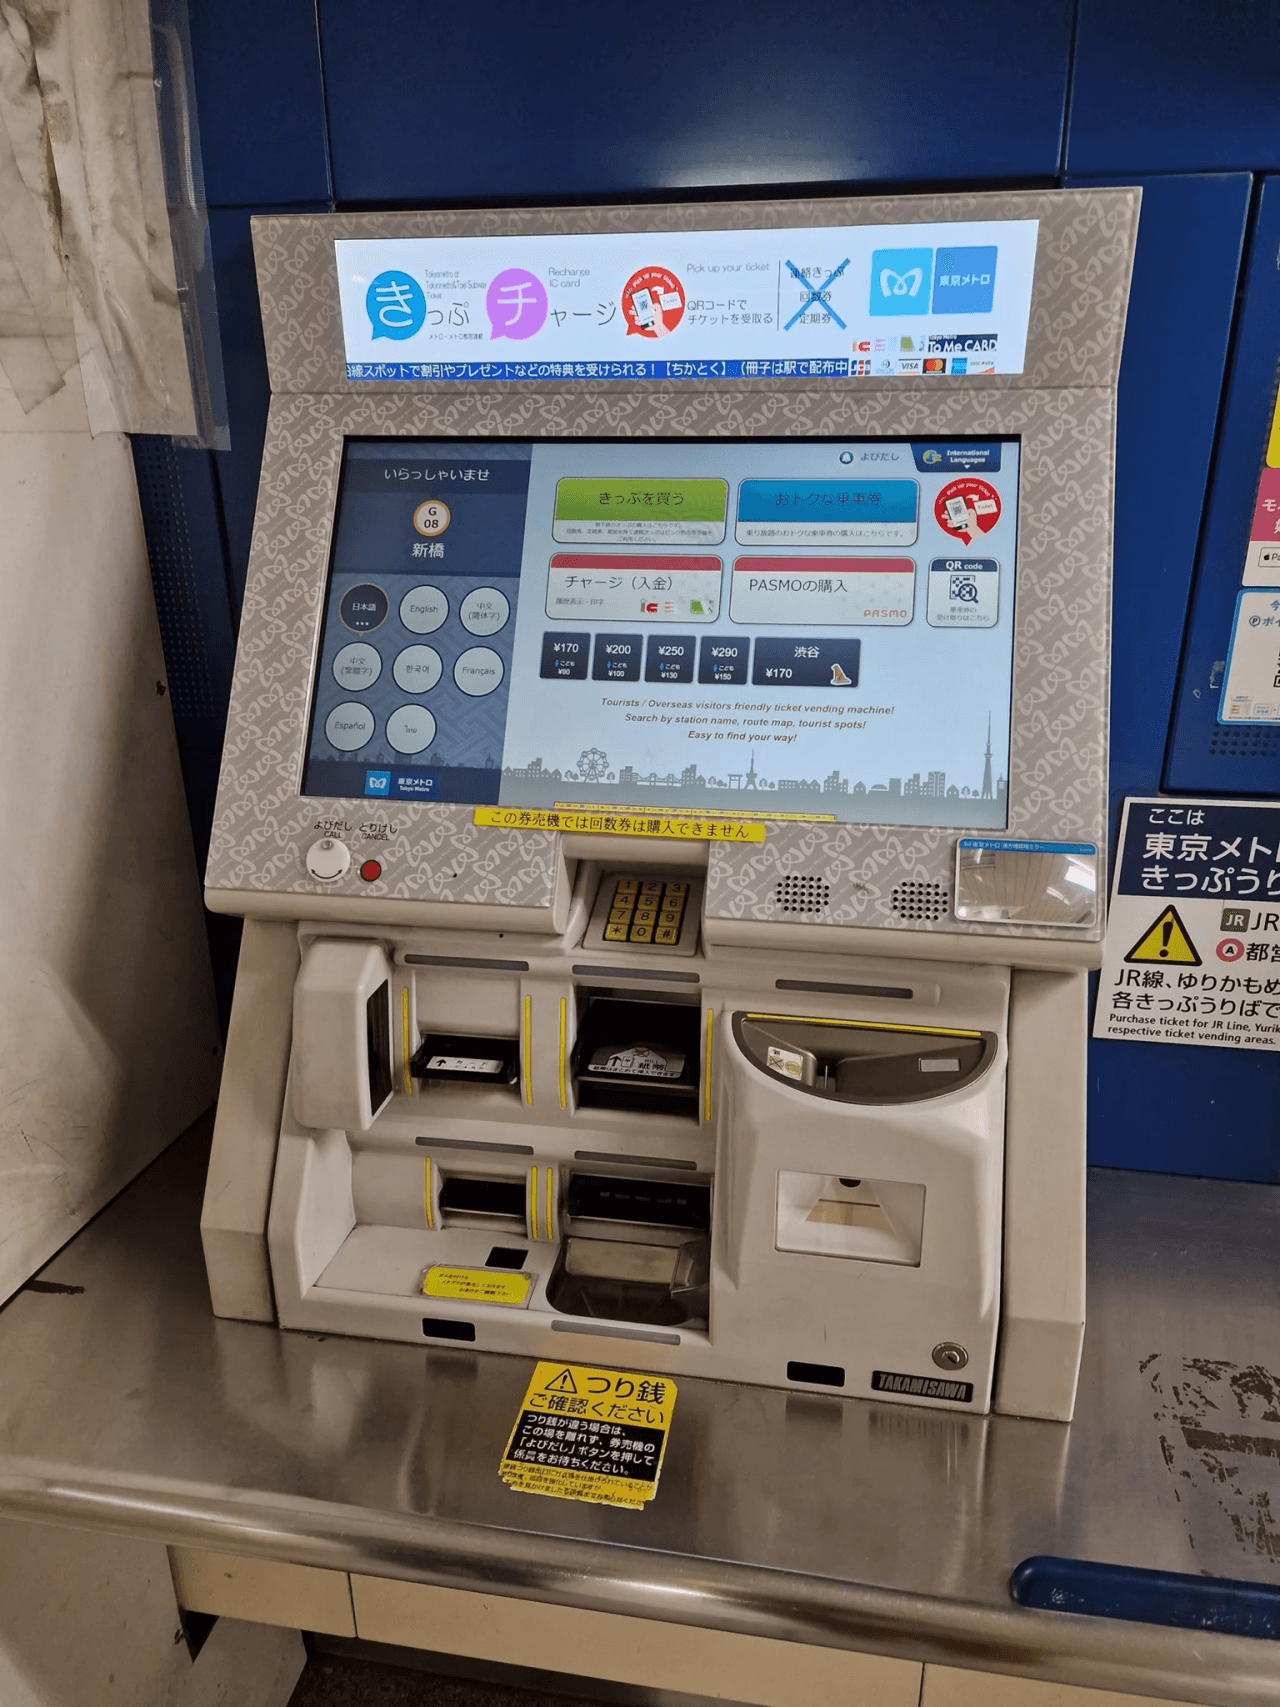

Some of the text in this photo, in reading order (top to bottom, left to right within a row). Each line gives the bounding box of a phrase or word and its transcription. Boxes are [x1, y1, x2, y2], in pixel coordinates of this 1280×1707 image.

[548, 267, 591, 278] Recharge
[687, 262, 770, 276] Pick up your ticket
[549, 278, 581, 288] IC card
[938, 273, 991, 287] 東京メトロ
[686, 299, 748, 311] QRコードで
[687, 312, 774, 326] チケットを受取る
[798, 312, 832, 325] 定期券
[964, 340, 998, 353] CARD
[901, 362, 919, 370] VISA
[859, 451, 900, 462] よびだし
[384, 468, 491, 482] いらっしゃいませ
[598, 492, 685, 506] きっぷを買う
[774, 492, 882, 507] おトクな乗車券
[428, 506, 437, 517] G
[424, 519, 439, 529] 08
[412, 542, 446, 559] 新橋
[946, 560, 963, 571] QR
[749, 579, 848, 593] PASMOの購入
[352, 602, 377, 612] 日本語
[410, 604, 439, 614] English
[477, 602, 493, 611] 中文
[863, 609, 908, 618] PASMO
[553, 643, 579, 653] ¥170
[605, 644, 631, 655] ¥200
[658, 646, 684, 657] ¥250
[711, 647, 738, 658] ¥290
[794, 645, 820, 658] 渋谷
[349, 656, 366, 665] 中文
[405, 664, 430, 674] 한국어
[462, 666, 496, 676] Français
[765, 668, 793, 679] ¥170
[601, 697, 640, 708] Tourists
[647, 698, 693, 710] Overseas
[695, 700, 732, 711] visitors
[734, 702, 771, 714] friendly
[774, 703, 802, 713] ticket
[804, 704, 845, 716] vending
[847, 705, 895, 715] machine!
[334, 721, 366, 731] Español
[624, 713, 866, 731] Search by station name, route map, tourist spots!
[687, 730, 797, 744] Easy to find your way!
[398, 777, 433, 787] 東京メトロ
[1149, 808, 1205, 826] ここは
[313, 820, 353, 832] よびだし
[358, 822, 398, 834] とりけし
[490, 810, 750, 839] この券売機では回数券は購入できません
[323, 830, 342, 839] CALL
[361, 832, 390, 841] CANCEL
[1142, 832, 1280, 863] 東京メト
[625, 881, 631, 889] 1
[648, 882, 657, 891] 2
[672, 884, 680, 892] 3
[619, 896, 629, 904] 4
[644, 897, 653, 906] 5
[669, 899, 678, 907] 6
[617, 910, 626, 919] 7
[640, 912, 650, 921] 8
[666, 913, 674, 922] 9
[1226, 914, 1244, 926] JR
[637, 927, 646, 937] 0
[1109, 1013, 1156, 1025] Purchase
[1159, 1016, 1190, 1027] ticket
[1193, 1018, 1209, 1028] for
[1211, 1020, 1224, 1029] JR
[1227, 1021, 1252, 1032] Line,
[1107, 1026, 1277, 1045] respective ticket vending areas.
[587, 1376, 667, 1405] つり銭
[878, 1373, 967, 1400] TAKAMISAWA
[529, 1392, 665, 1424] ご確認ください
[527, 1413, 627, 1437] つり銭が違う場合は、
[522, 1424, 656, 1453] この場を離れず、券売機の
[519, 1436, 655, 1466] 「よびだし」ボタンを押して
[513, 1448, 630, 1475] 係員をお待ちください。
